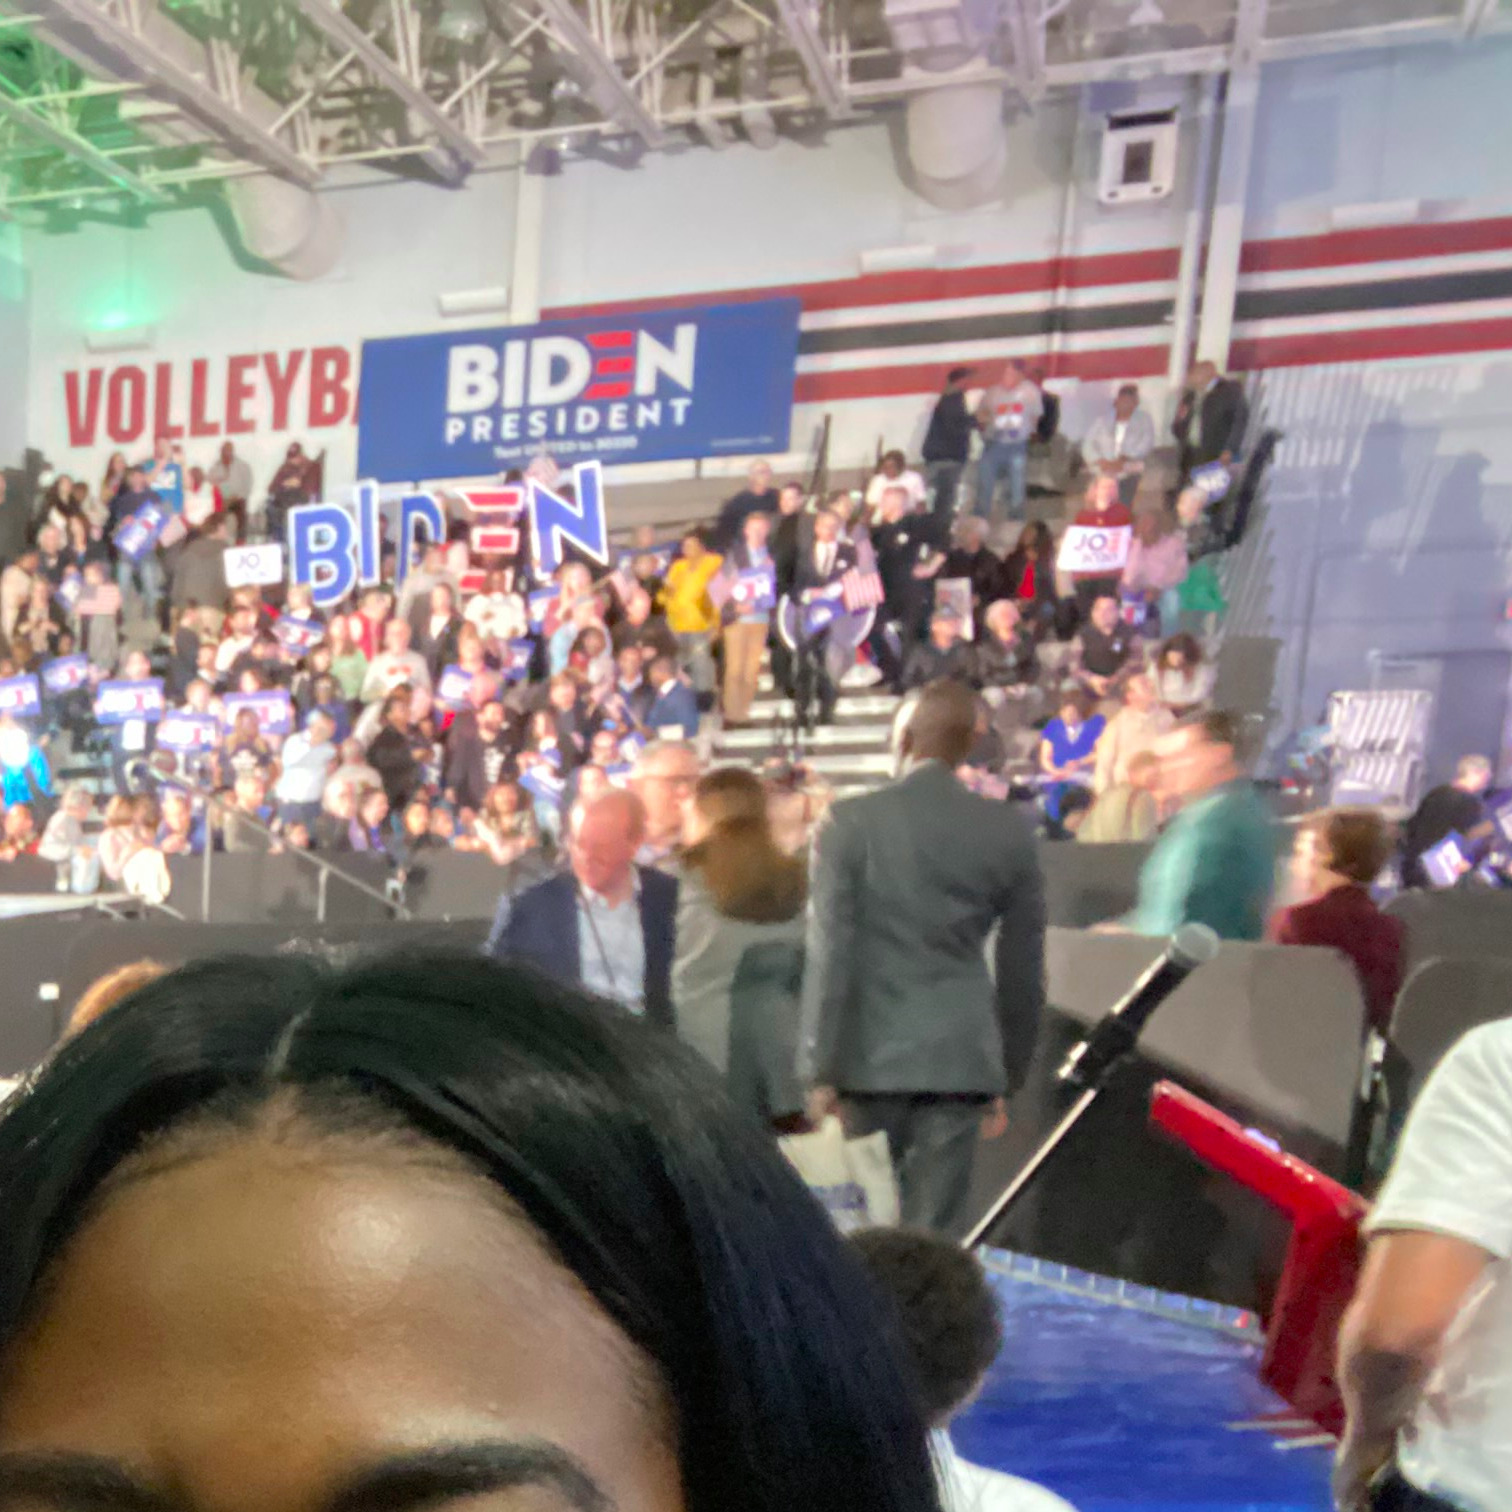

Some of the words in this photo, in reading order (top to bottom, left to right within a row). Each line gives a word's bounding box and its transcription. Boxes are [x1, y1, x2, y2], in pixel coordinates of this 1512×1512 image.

[63, 345, 358, 448] VOLLEYB
[446, 322, 698, 414] BIDEN
[444, 397, 692, 445] PRESIDENT
